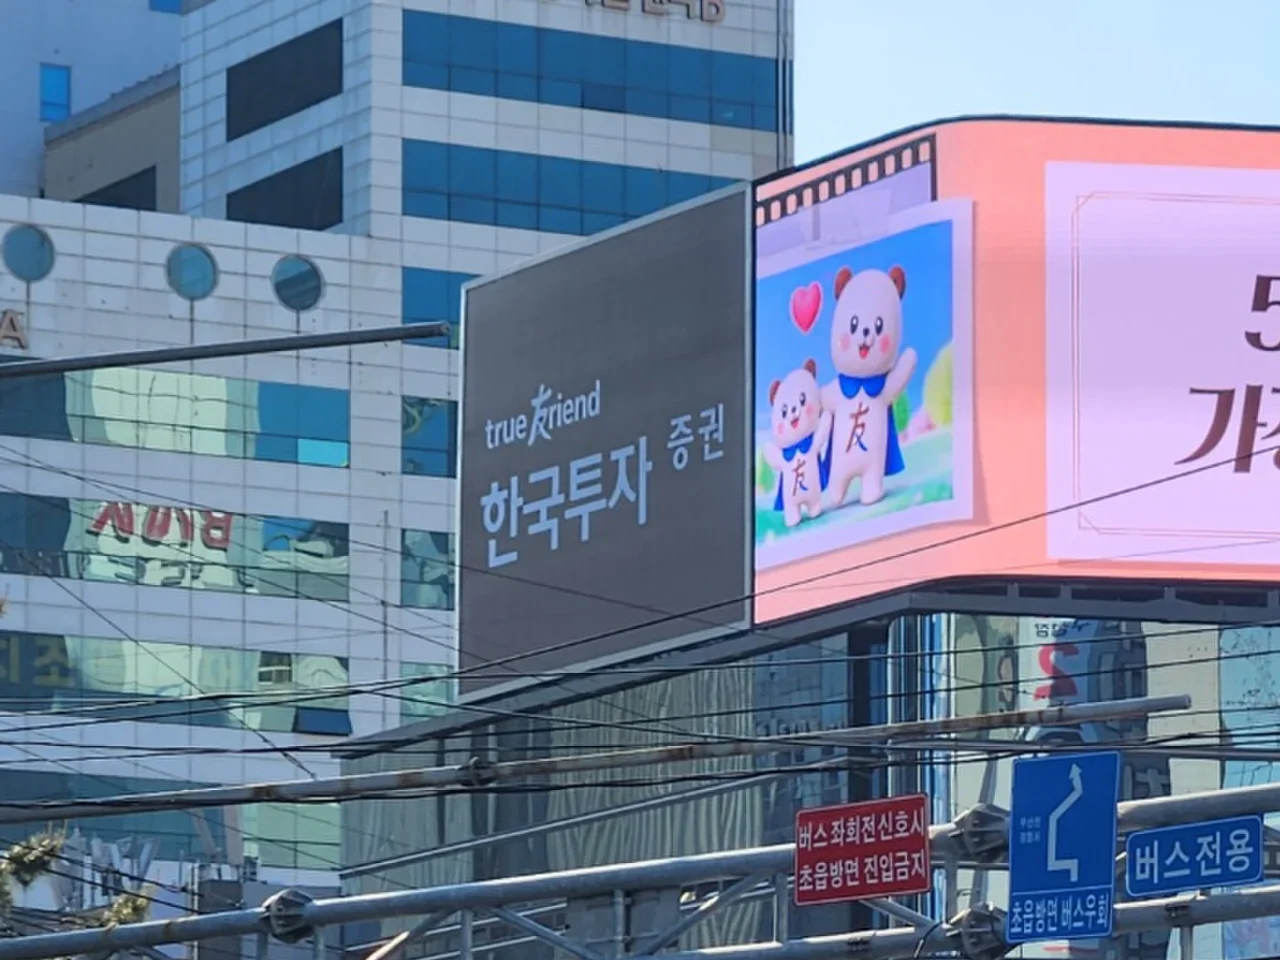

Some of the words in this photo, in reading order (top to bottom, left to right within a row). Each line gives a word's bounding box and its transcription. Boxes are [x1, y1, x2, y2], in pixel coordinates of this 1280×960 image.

[480, 436, 653, 568] 한국투자
[667, 403, 724, 470] 증권
[799, 821, 829, 851] 버스
[1135, 827, 1253, 884] 버스전용
[799, 859, 860, 892] 초읍방면
[864, 849, 926, 885] 진입금지
[1010, 901, 1058, 934] 초읍방면
